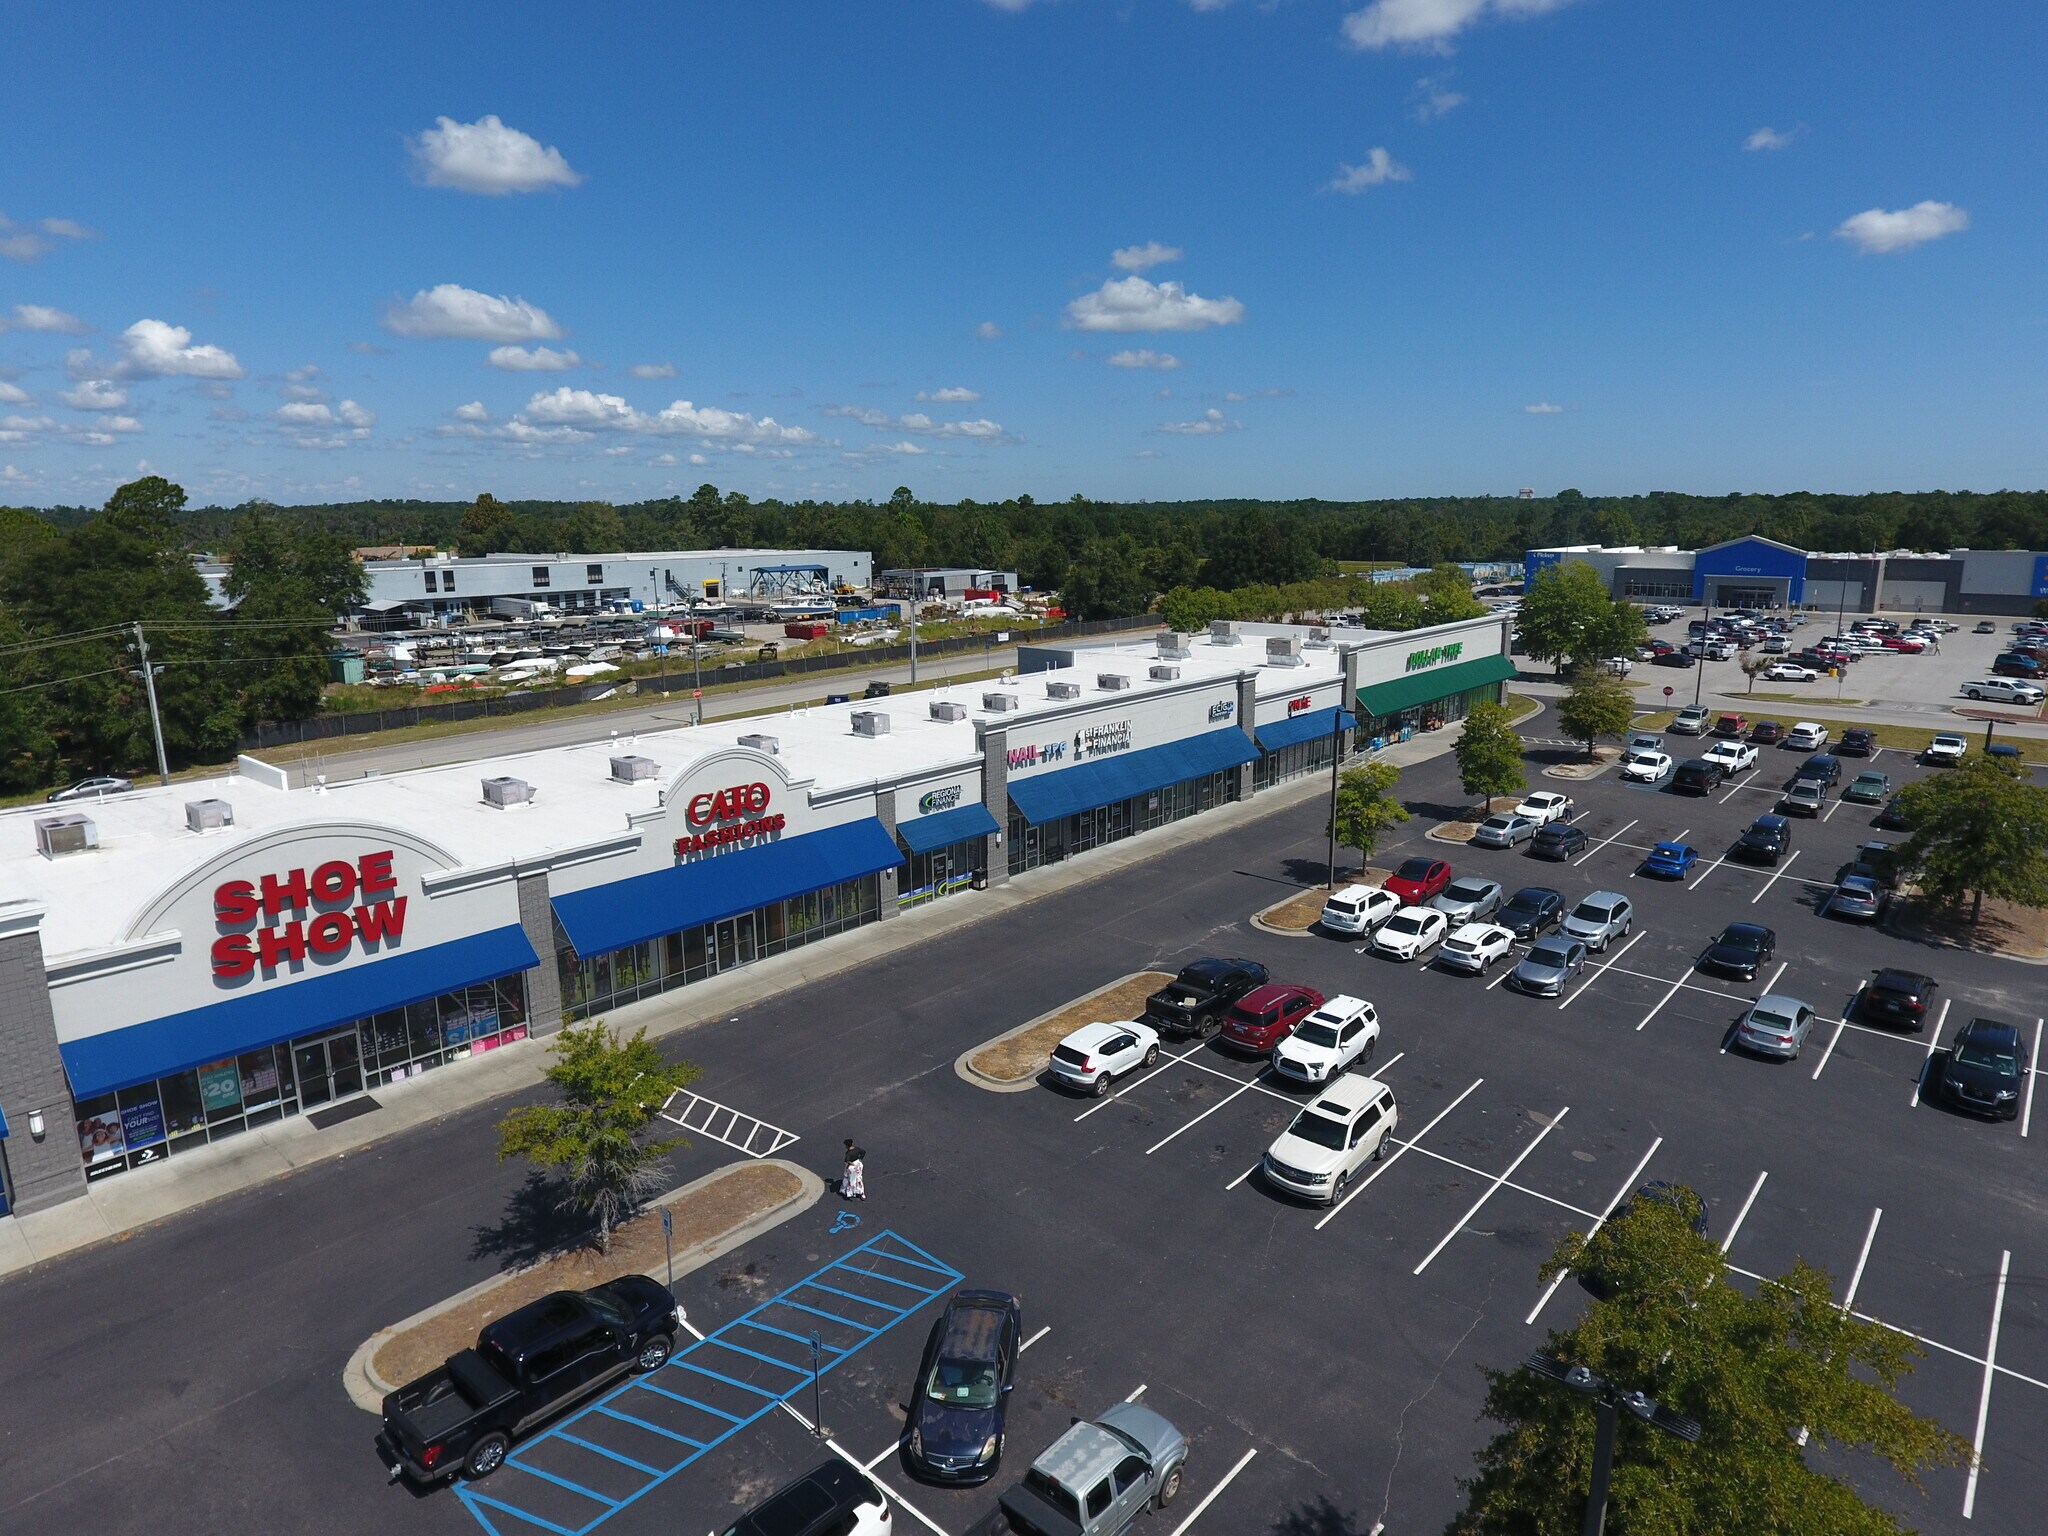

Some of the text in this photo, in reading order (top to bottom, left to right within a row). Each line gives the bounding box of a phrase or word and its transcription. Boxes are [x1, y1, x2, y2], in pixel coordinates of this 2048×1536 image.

[1735, 565, 1761, 574] Grocery
[1094, 720, 1132, 738] FRANKLIN
[1094, 732, 1133, 748] FINANCIAL
[1008, 741, 1067, 763] NAIL SPA
[688, 782, 770, 825] CATO
[676, 813, 785, 855] FASHIONS
[214, 850, 397, 924] SHOE
[211, 896, 407, 978] SHOW
[203, 1079, 235, 1097] $20
[120, 1100, 158, 1115] SHOE SHOW
[124, 1117, 148, 1129] YOUR
